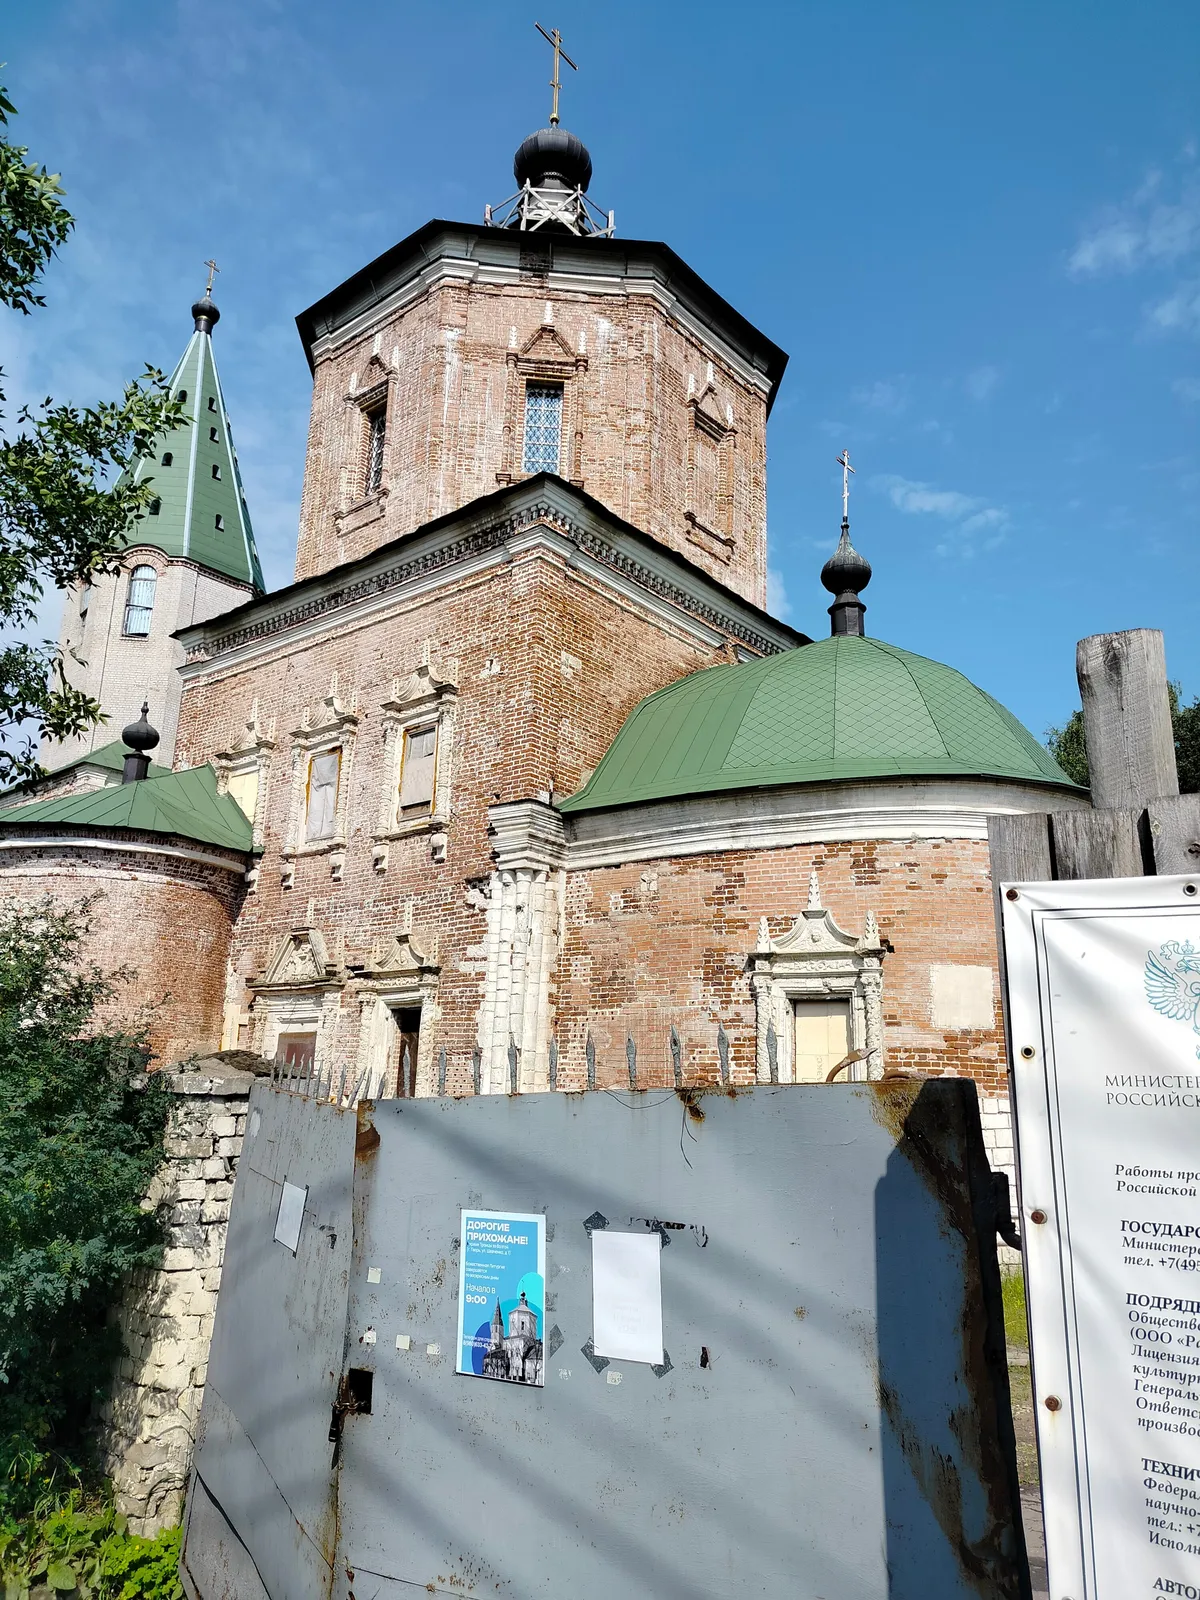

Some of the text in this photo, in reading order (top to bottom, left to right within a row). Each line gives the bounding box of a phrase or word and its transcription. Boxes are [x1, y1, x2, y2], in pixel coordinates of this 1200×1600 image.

[1115, 1164, 1173, 1179] Работы
[1116, 1180, 1197, 1197] Российской
[467, 1220, 510, 1232] ДОРОГИЕ
[467, 1231, 529, 1245] ПРИХОЖАНЕ!
[1124, 1256, 1154, 1267] тел.
[466, 1283, 491, 1293] Начало
[465, 1294, 487, 1305] 9:00
[1130, 1326, 1172, 1344] (ООО
[1131, 1344, 1200, 1366] Лицензия
[1136, 1396, 1200, 1420] Ответс
[1145, 1497, 1200, 1518] научно-
[1147, 1516, 1182, 1533] тел.:
[1152, 1576, 1200, 1600] АВТО
